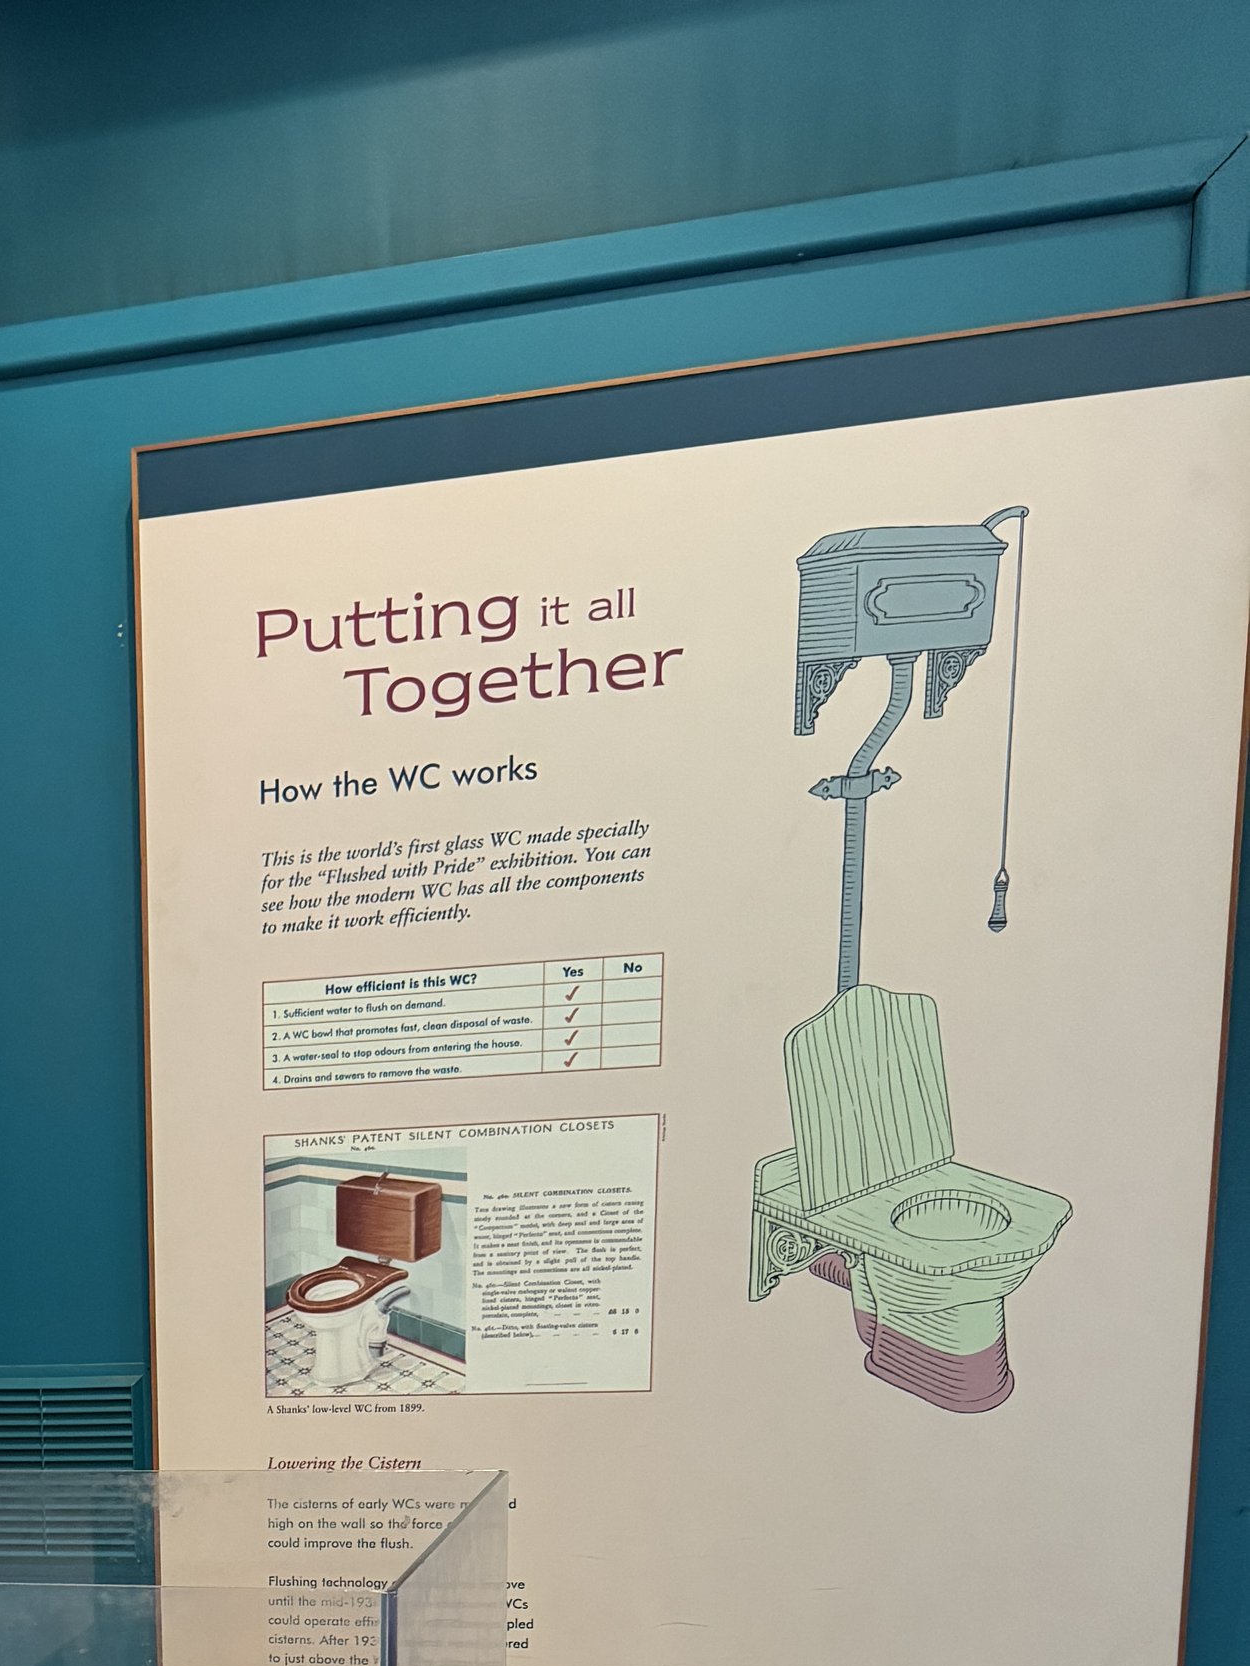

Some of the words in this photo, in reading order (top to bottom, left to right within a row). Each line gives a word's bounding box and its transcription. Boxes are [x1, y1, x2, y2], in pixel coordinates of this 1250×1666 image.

[256, 592, 519, 658] Putting
[541, 596, 571, 627] it
[588, 587, 636, 623] all
[343, 648, 684, 719] Together
[261, 779, 323, 805] How
[333, 771, 378, 798] the
[389, 763, 440, 792] WC
[452, 755, 538, 786] works
[262, 851, 294, 867] This
[300, 850, 312, 864] is
[318, 846, 342, 863] the
[408, 839, 440, 861] first
[444, 835, 484, 858] glass
[491, 830, 522, 848] WC
[527, 826, 572, 844] made
[576, 819, 650, 844] specially
[262, 874, 285, 894] for
[289, 872, 312, 888] the
[392, 861, 428, 879] with
[490, 850, 577, 870] exhibition.
[586, 847, 616, 862] You
[622, 847, 651, 860] can
[262, 901, 284, 912] see
[289, 894, 322, 910] how
[327, 891, 350, 907] the
[356, 886, 415, 904] modern
[422, 882, 452, 898] WC
[457, 880, 484, 896] has
[489, 876, 512, 894] all
[516, 875, 541, 891] the
[546, 869, 645, 890] components
[262, 922, 277, 934] to
[282, 916, 323, 933] make
[328, 914, 340, 929] it
[345, 910, 384, 928] work
[390, 904, 470, 928] efficiently.
[326, 984, 353, 995] How
[356, 980, 406, 993] efficient
[410, 978, 419, 989] is
[423, 976, 446, 988] this
[450, 974, 477, 986] WC?
[562, 966, 584, 978] Yes
[623, 962, 643, 974] No
[274, 1010, 280, 1019] 1.
[284, 1008, 324, 1018] Sufficient
[326, 1007, 352, 1015] water
[366, 1002, 388, 1012] flush
[405, 998, 446, 1010] demand.
[273, 1077, 281, 1085] 4.
[284, 1075, 312, 1084] Drains
[315, 1072, 332, 1082] and
[335, 1073, 365, 1081] sewers
[368, 1071, 377, 1079] to
[379, 1070, 413, 1078] remove
[416, 1067, 430, 1076] the
[433, 1066, 462, 1074] waste.
[353, 1132, 402, 1144] PATENT
[409, 1130, 452, 1141] SILENT
[459, 1124, 552, 1138] COMBINATION
[560, 1120, 614, 1132] CLOSETS
[267, 1406, 274, 1414] A
[312, 1404, 351, 1414] low-level
[354, 1404, 372, 1413] WC
[375, 1404, 396, 1413] from
[401, 1404, 425, 1412] 1899.
[268, 1457, 336, 1474] Lowering
[341, 1456, 363, 1470] the
[368, 1456, 422, 1470] Cistern
[267, 1498, 289, 1509] The
[293, 1500, 338, 1509] cisterns
[342, 1498, 354, 1510] of
[358, 1498, 388, 1512] early
[392, 1498, 421, 1509] WCs
[425, 1502, 455, 1510] were
[268, 1518, 294, 1531] high
[298, 1521, 313, 1529] on
[318, 1518, 337, 1528] the
[341, 1518, 365, 1529] wall
[370, 1521, 384, 1529] so
[412, 1518, 443, 1529] force
[268, 1537, 300, 1548] could
[304, 1538, 353, 1551] improve
[357, 1538, 376, 1548] the
[380, 1538, 413, 1549] flush.
[269, 1576, 317, 1589] Flushing
[322, 1576, 388, 1589] technology
[269, 1654, 281, 1663] to
[285, 1653, 305, 1666] just
[309, 1654, 345, 1665] above
[350, 1654, 369, 1666] the
